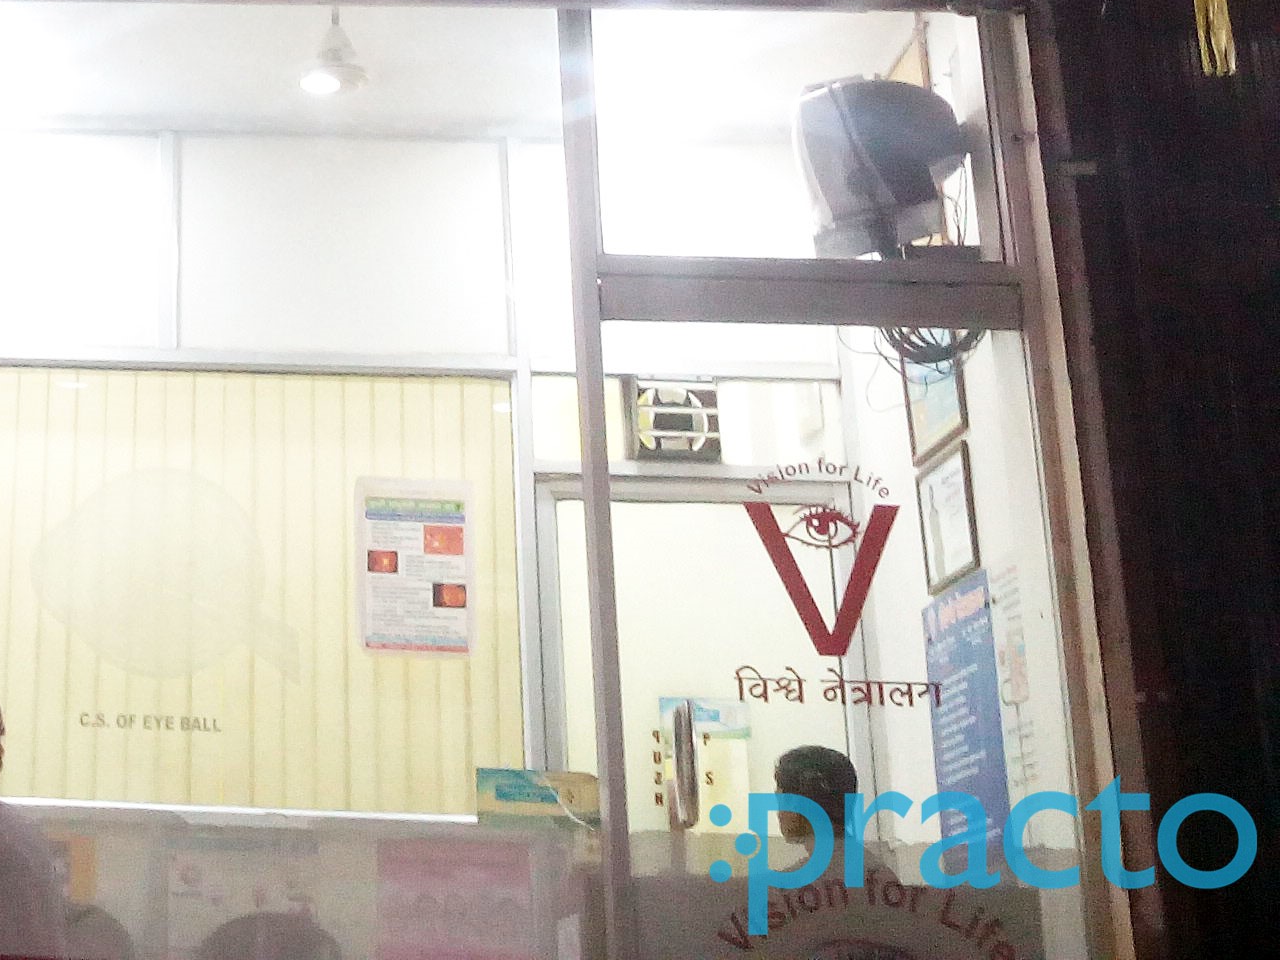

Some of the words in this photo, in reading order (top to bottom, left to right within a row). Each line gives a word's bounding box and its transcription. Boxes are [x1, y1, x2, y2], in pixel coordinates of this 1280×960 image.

[817, 457, 847, 476] for
[853, 466, 890, 499] Life
[80, 712, 110, 728] C.S.
[116, 713, 136, 729] OF
[143, 714, 175, 731] EYE
[180, 715, 222, 732] BALL
